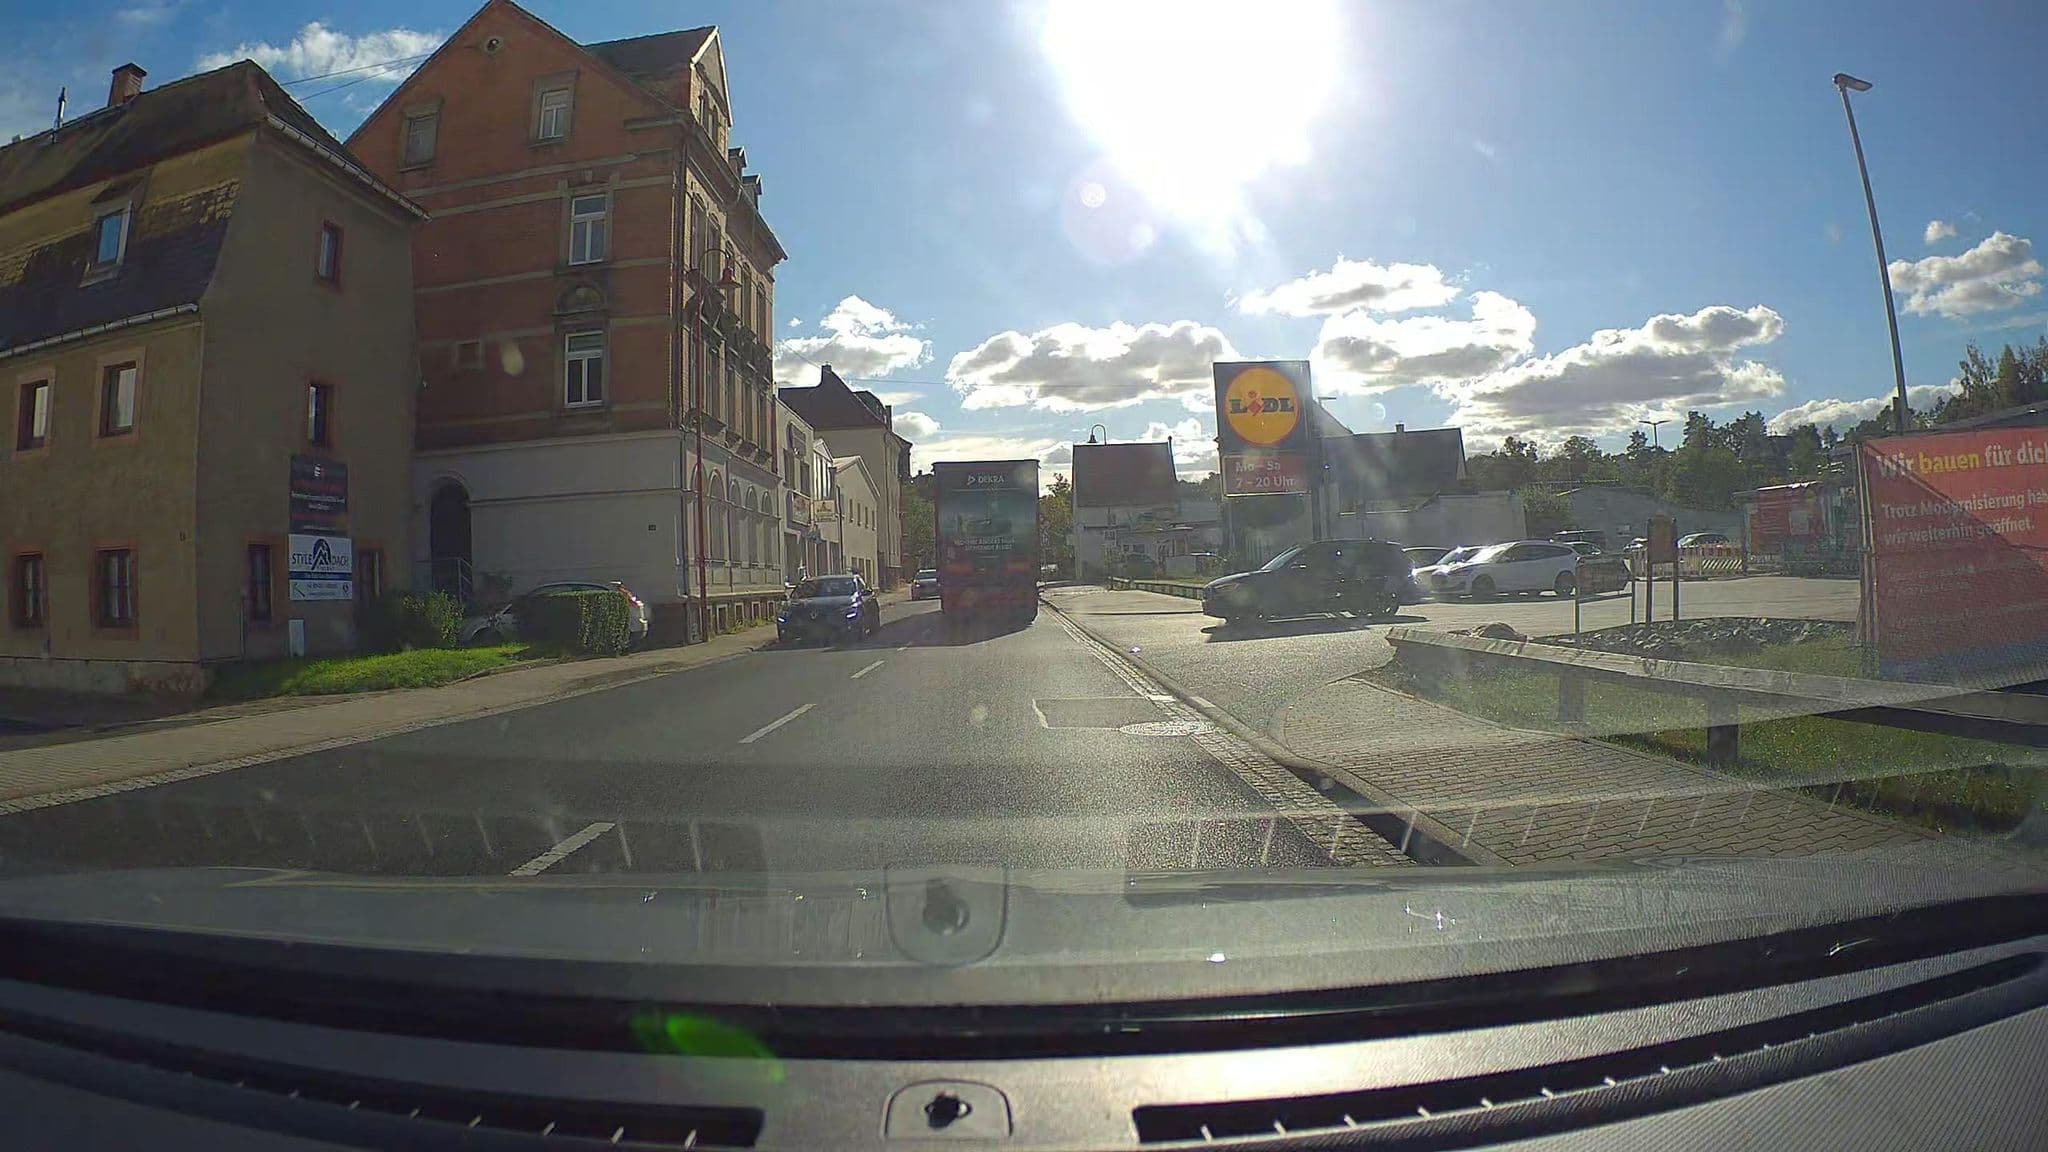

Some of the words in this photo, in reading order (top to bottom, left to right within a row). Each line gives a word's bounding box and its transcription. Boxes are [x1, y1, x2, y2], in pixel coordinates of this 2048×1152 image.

[1229, 391, 1295, 416] LIDL
[1875, 452, 1915, 476] Wir
[1918, 451, 1980, 475] bauen
[1984, 444, 2012, 468] für
[978, 475, 1005, 484] DEKRA
[1255, 477, 1271, 488] 20
[1274, 475, 1295, 488] Uhr
[1882, 503, 1918, 520] Trotz
[1920, 492, 2025, 516] Modernisierung
[1884, 530, 1907, 546] wir
[1908, 523, 1974, 543] weiterhin
[1976, 516, 2036, 540] geöffnet.
[292, 553, 313, 565] STYLE
